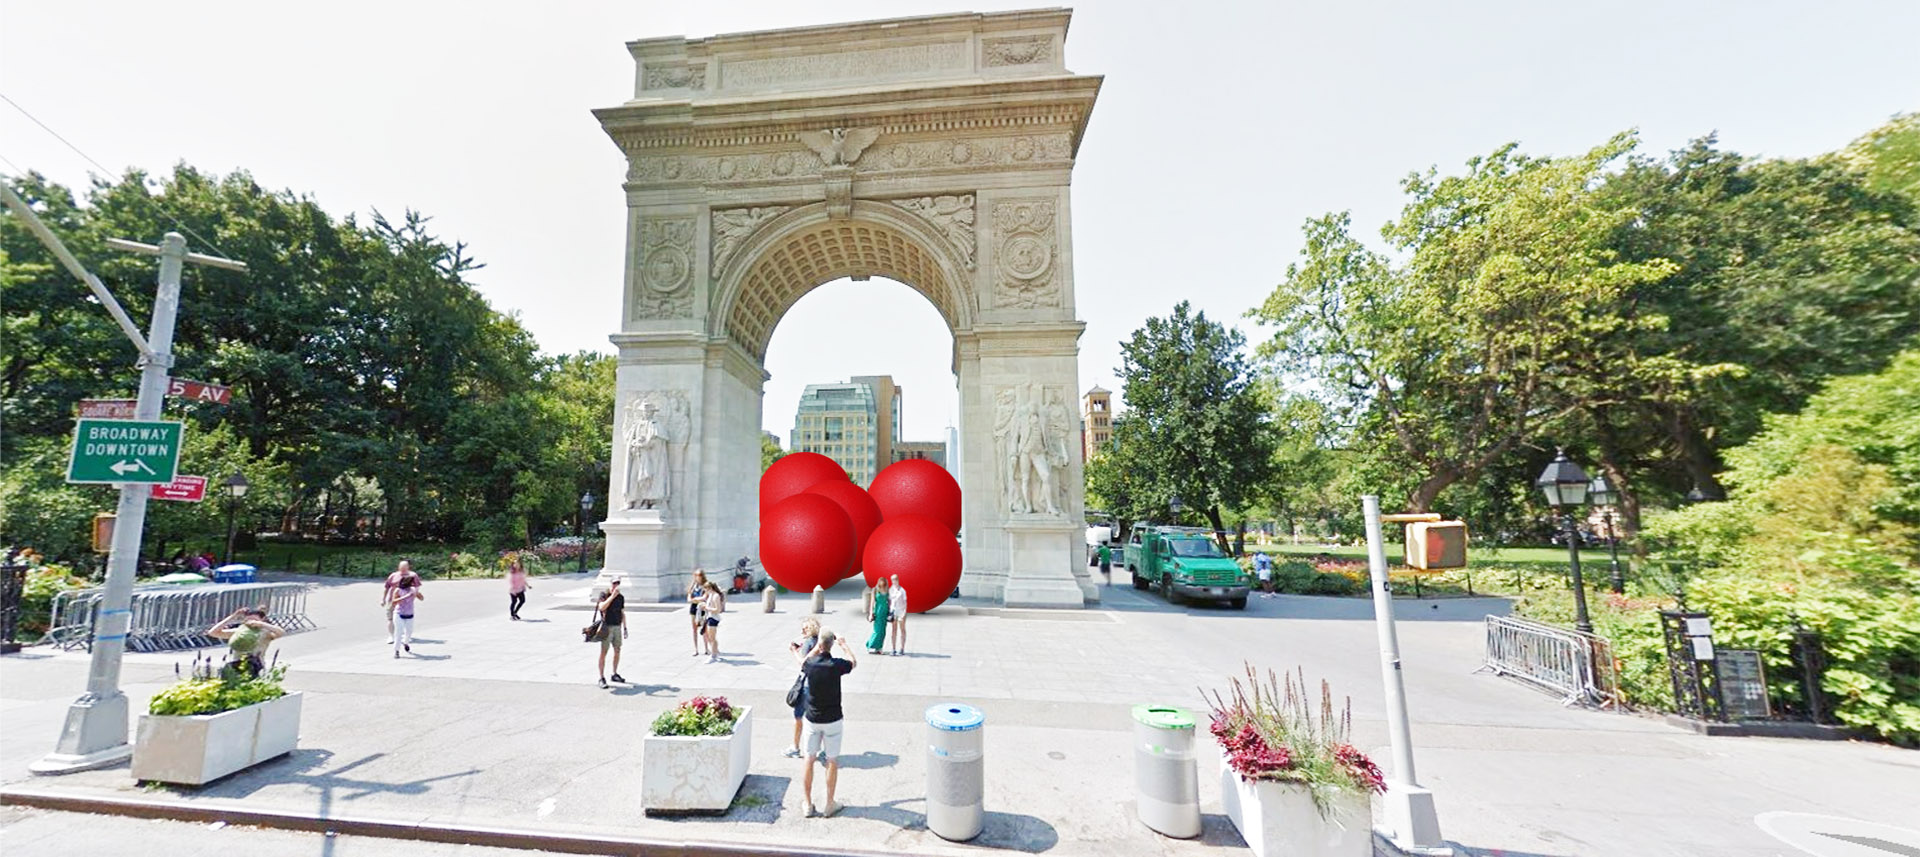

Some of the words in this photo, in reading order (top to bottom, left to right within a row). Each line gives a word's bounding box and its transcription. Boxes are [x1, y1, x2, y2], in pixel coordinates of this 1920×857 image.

[171, 381, 185, 396] 5
[198, 386, 224, 401] AV
[89, 427, 169, 441] BROADWAY
[85, 443, 169, 456] DOWNTOWN
